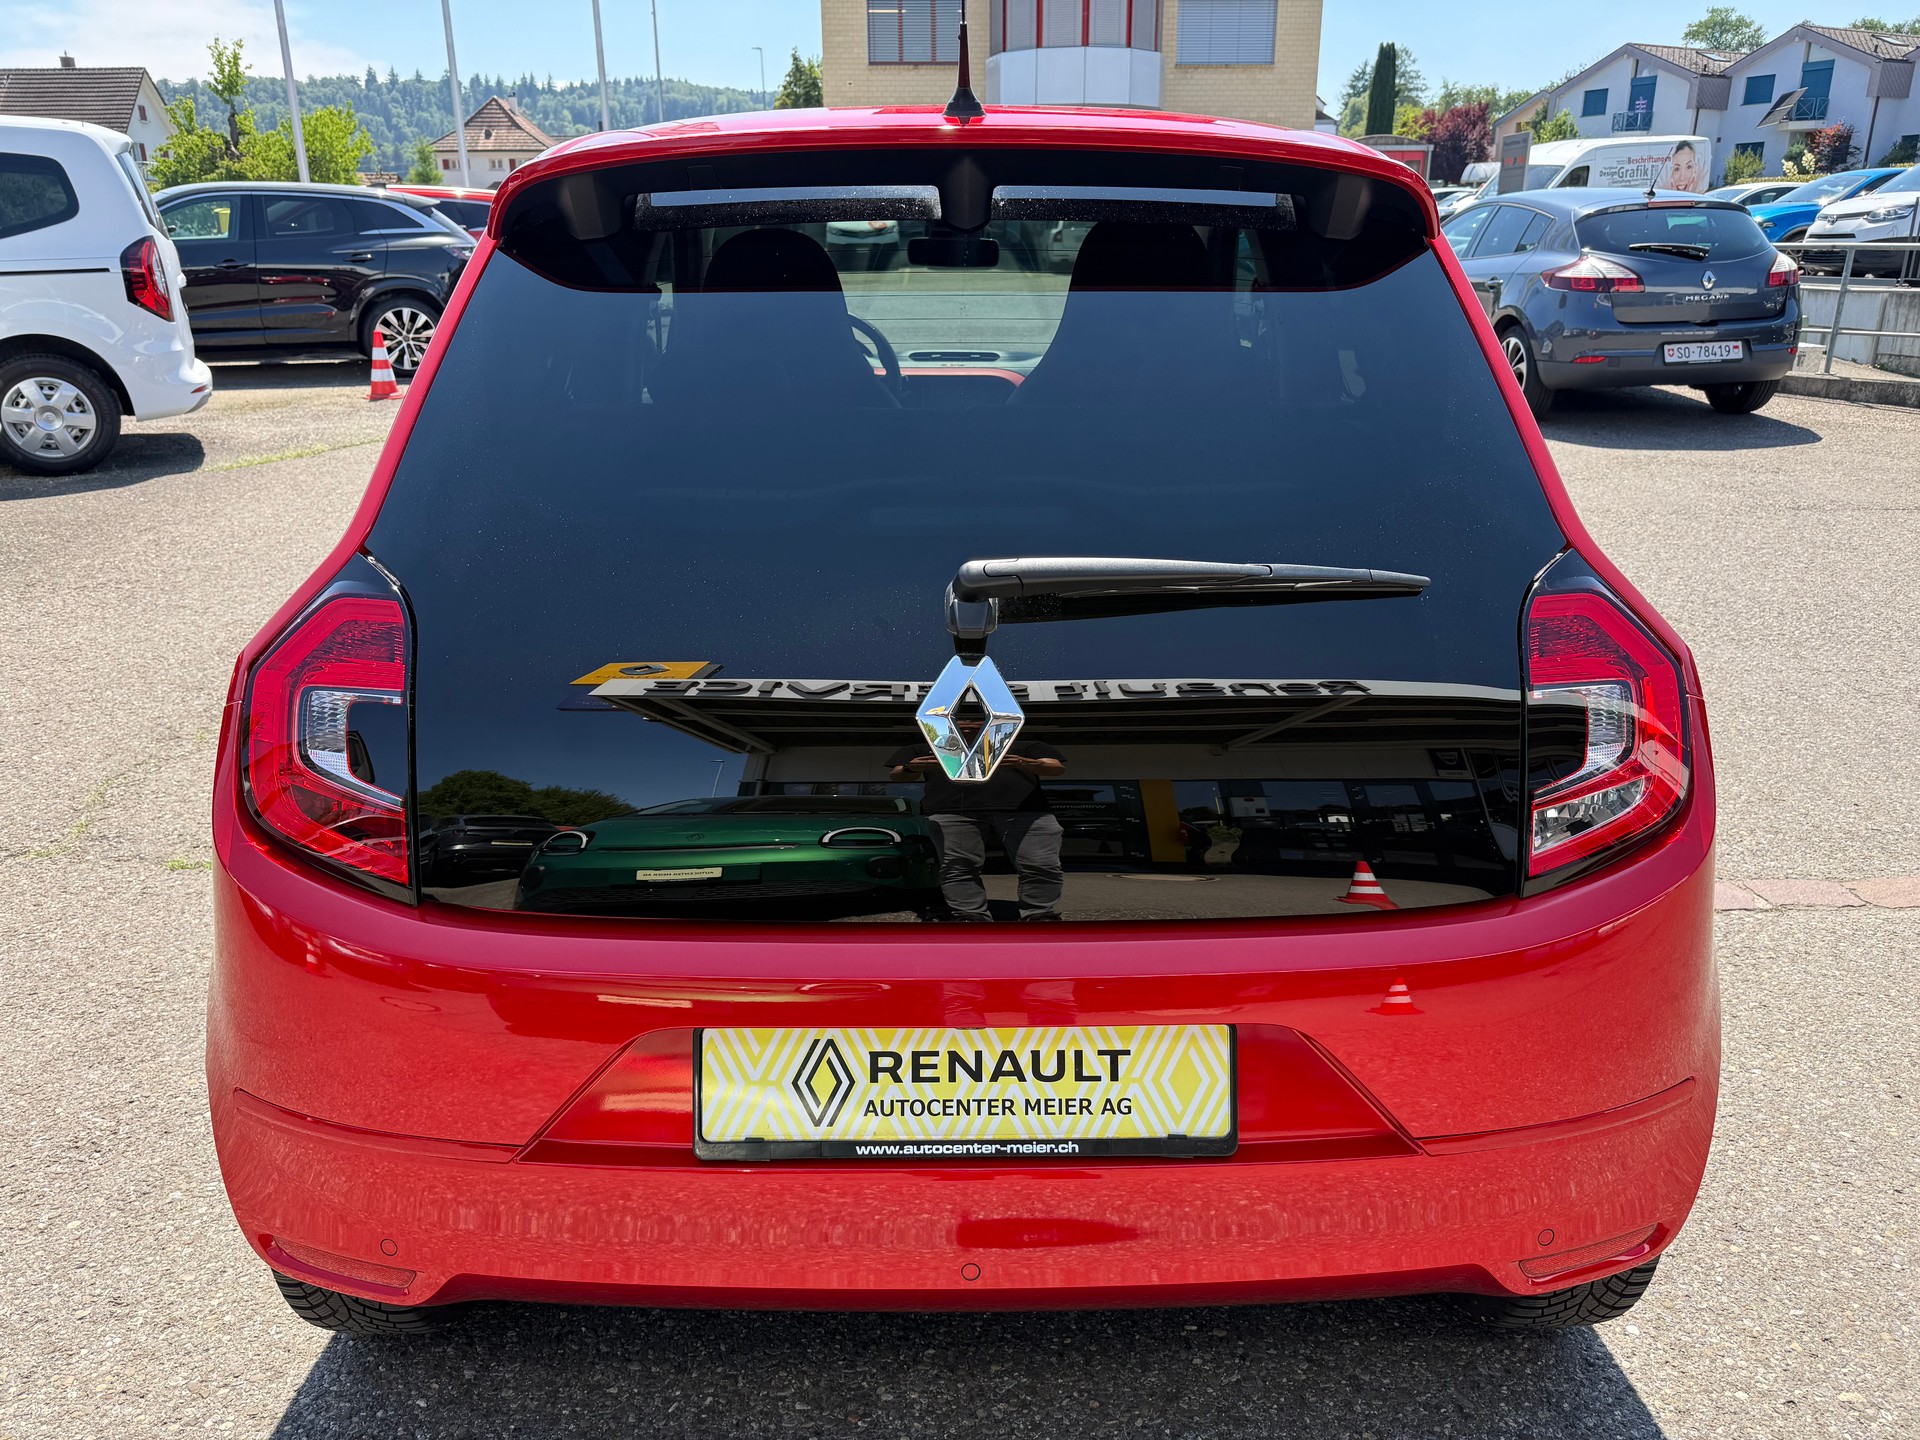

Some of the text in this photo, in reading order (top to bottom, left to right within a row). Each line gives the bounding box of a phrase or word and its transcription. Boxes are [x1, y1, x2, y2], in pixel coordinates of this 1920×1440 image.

[1627, 155, 1672, 165] Beschriftungen
[1599, 170, 1618, 178] Design
[1617, 164, 1649, 179] Grafik
[869, 1049, 1131, 1083] RENAULT
[863, 1097, 1132, 1117] AUTOCENTER MEIER AG
[855, 1141, 1080, 1156] www.autocenter-meier.ch
